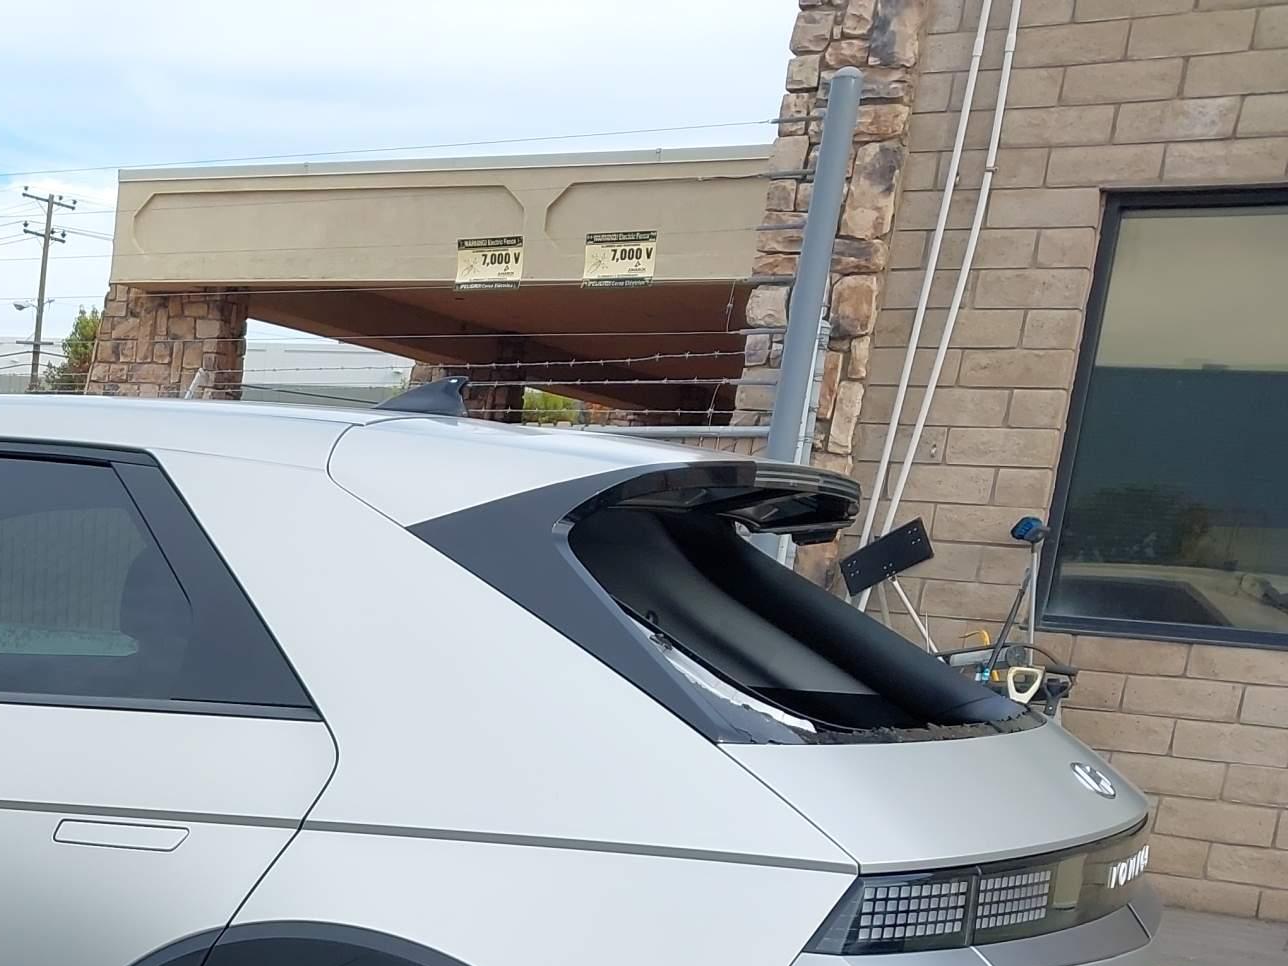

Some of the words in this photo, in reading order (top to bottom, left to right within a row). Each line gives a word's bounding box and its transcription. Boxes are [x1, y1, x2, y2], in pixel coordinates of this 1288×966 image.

[481, 252, 511, 267] 7,000
[513, 251, 521, 265] V
[611, 248, 642, 262] 7,000
[645, 247, 653, 260] V
